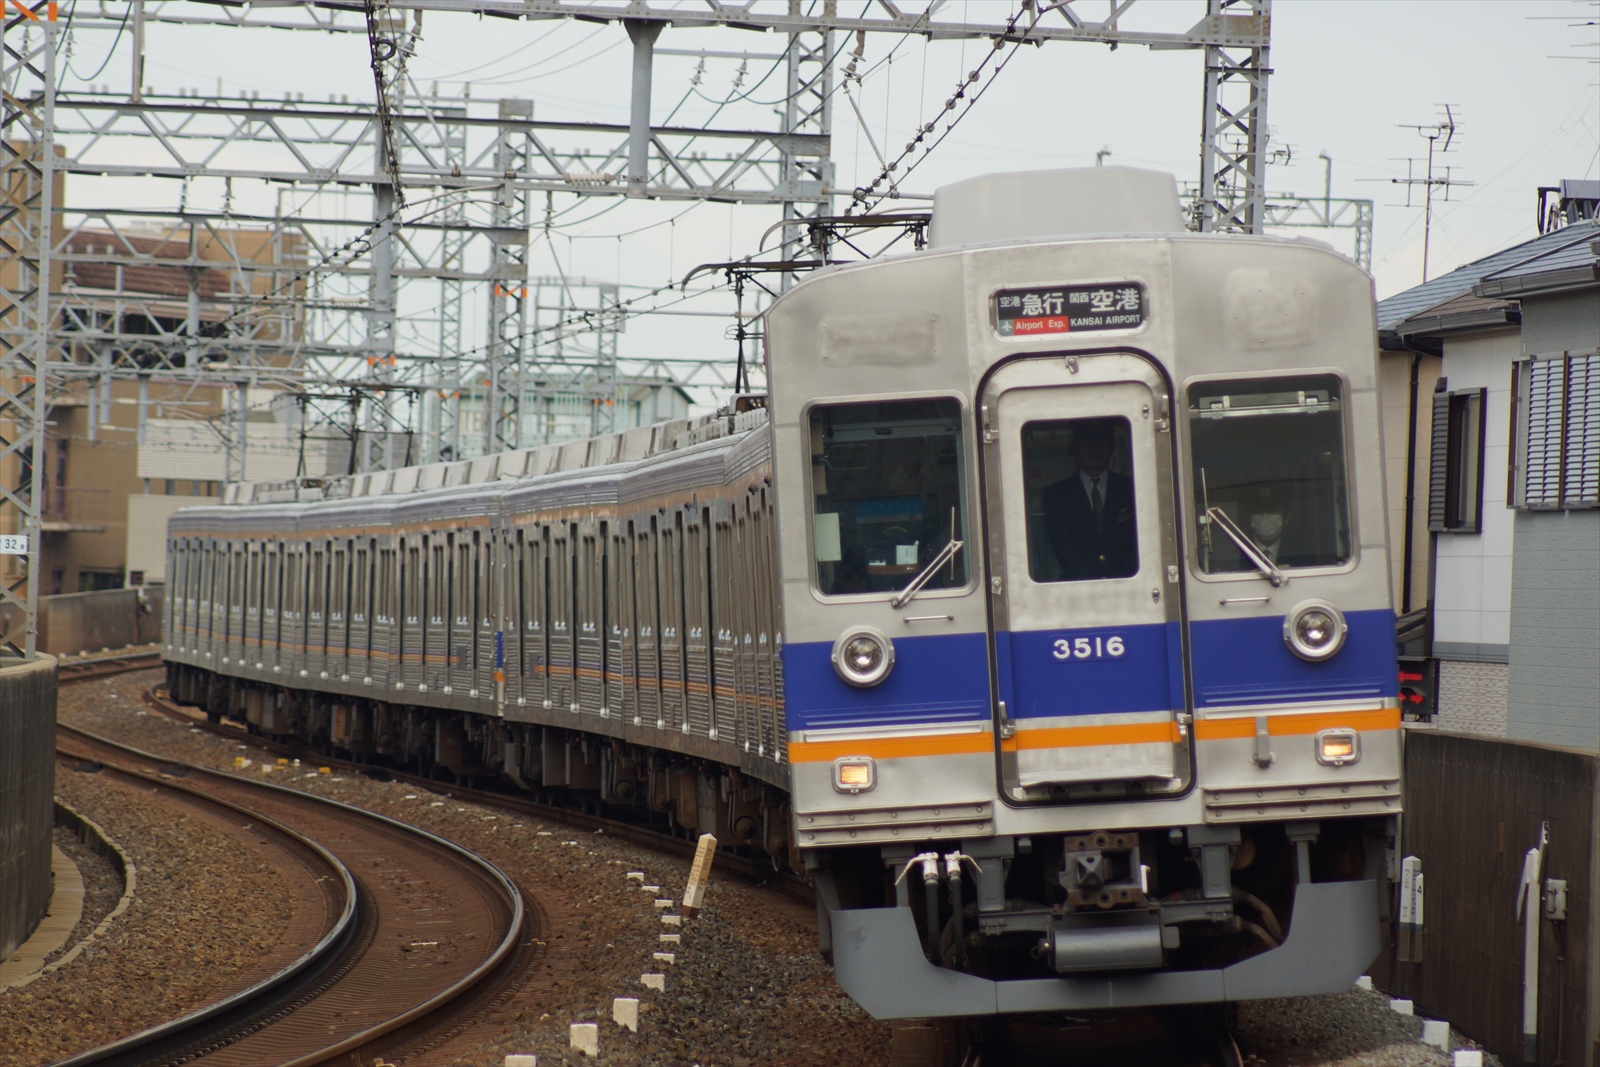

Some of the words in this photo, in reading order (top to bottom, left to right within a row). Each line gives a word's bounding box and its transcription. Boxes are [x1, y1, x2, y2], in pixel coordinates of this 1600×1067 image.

[1015, 320, 1043, 331] Airport
[1048, 319, 1065, 330] Exp.
[1070, 316, 1103, 327] KANSAI
[1105, 314, 1141, 325] AIRPORT
[1053, 636, 1125, 659] 3516
